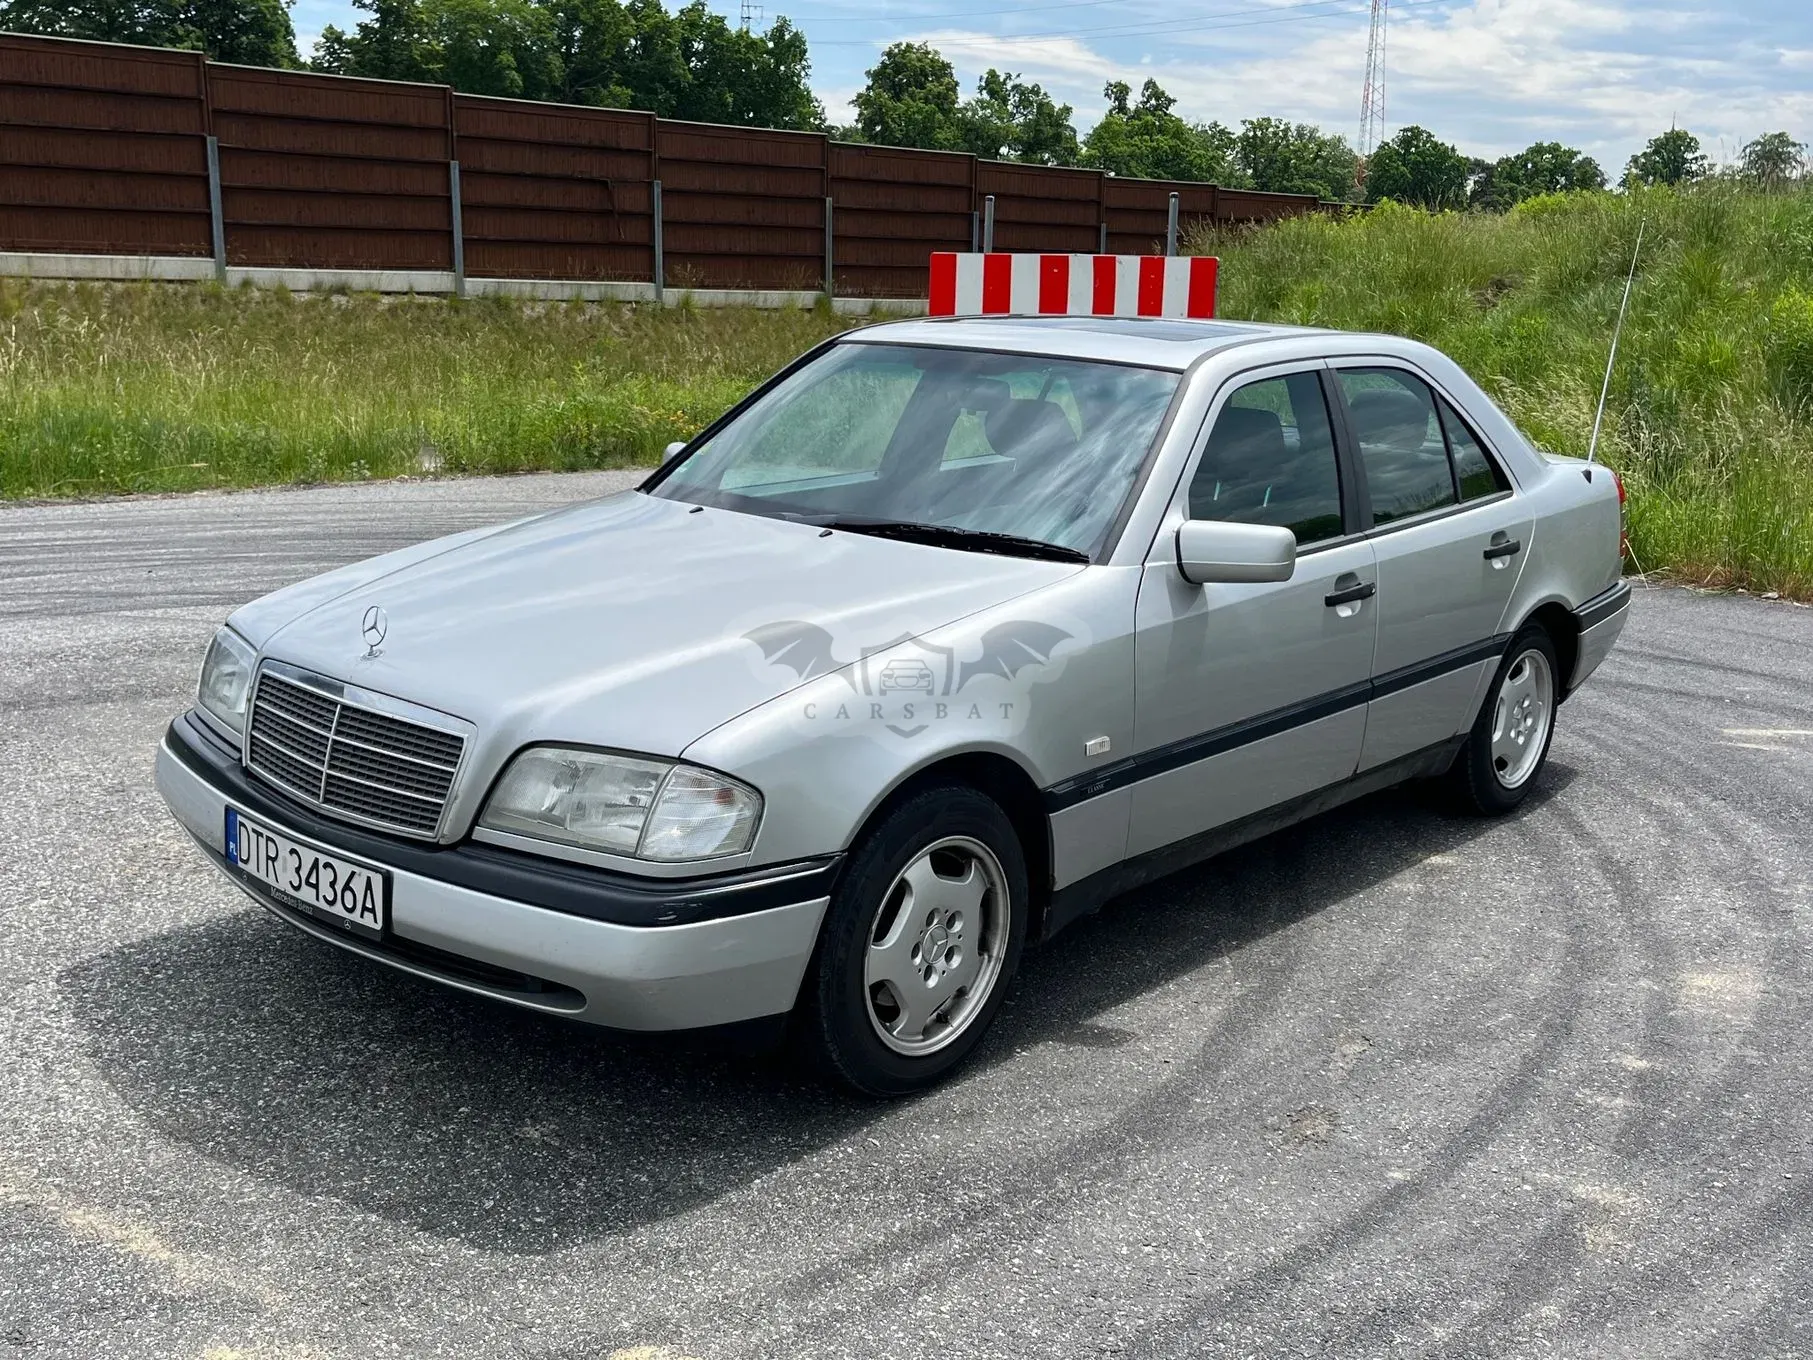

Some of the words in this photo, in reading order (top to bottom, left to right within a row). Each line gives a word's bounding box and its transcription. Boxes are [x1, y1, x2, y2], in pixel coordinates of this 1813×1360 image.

[229, 841, 238, 856] PL
[238, 820, 280, 884] DTR
[288, 847, 379, 925] 3436A
